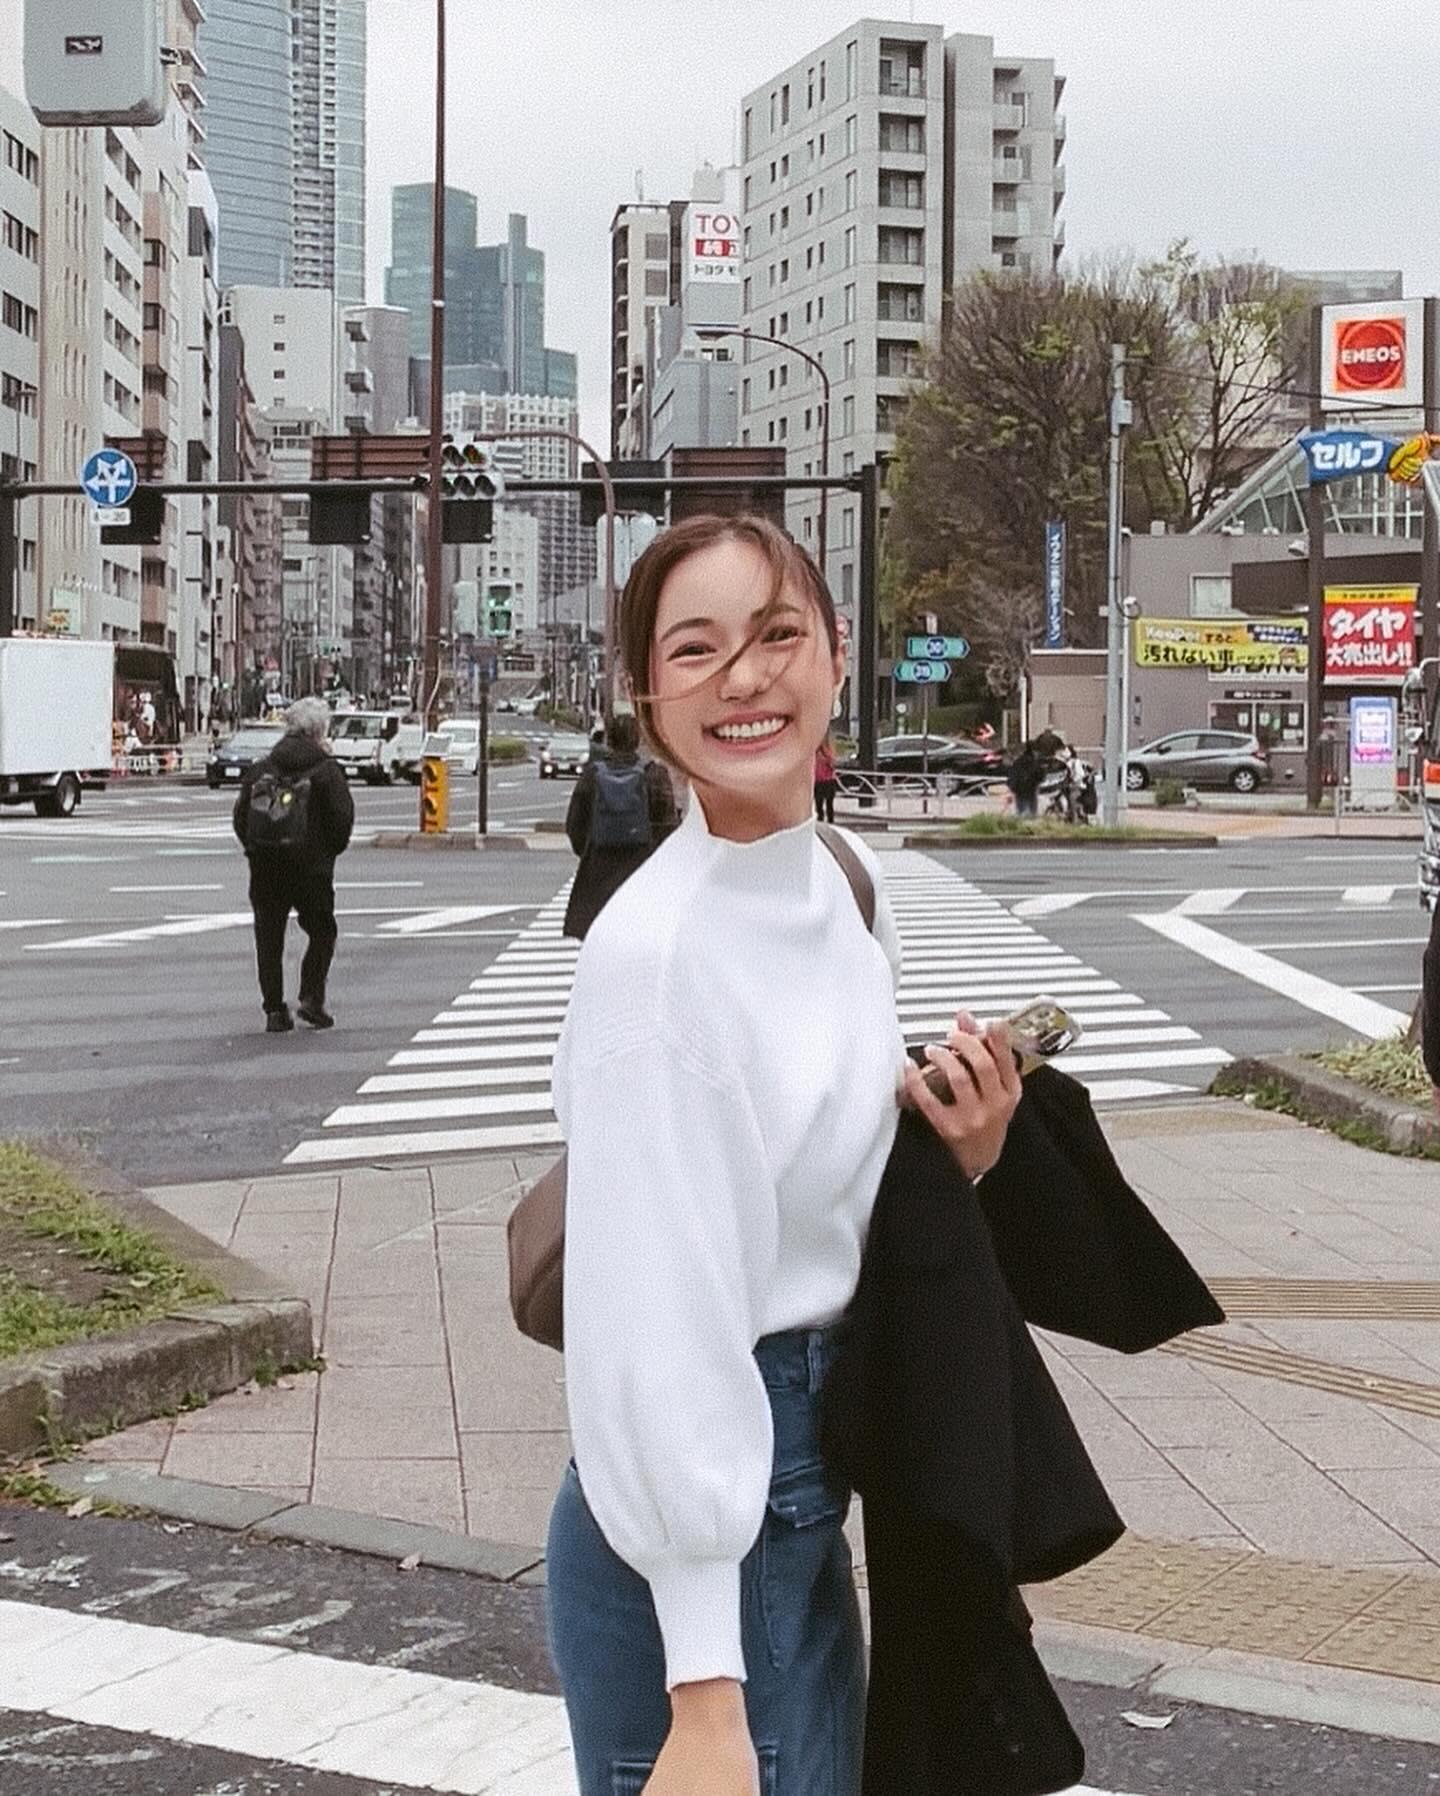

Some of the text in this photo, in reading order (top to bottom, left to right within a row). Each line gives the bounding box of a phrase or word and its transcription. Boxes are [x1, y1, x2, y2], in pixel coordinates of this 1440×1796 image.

[1311, 439, 1384, 469] セルフ
[1328, 608, 1407, 640] タイヤ
[1326, 641, 1413, 667] 大売出し!!
